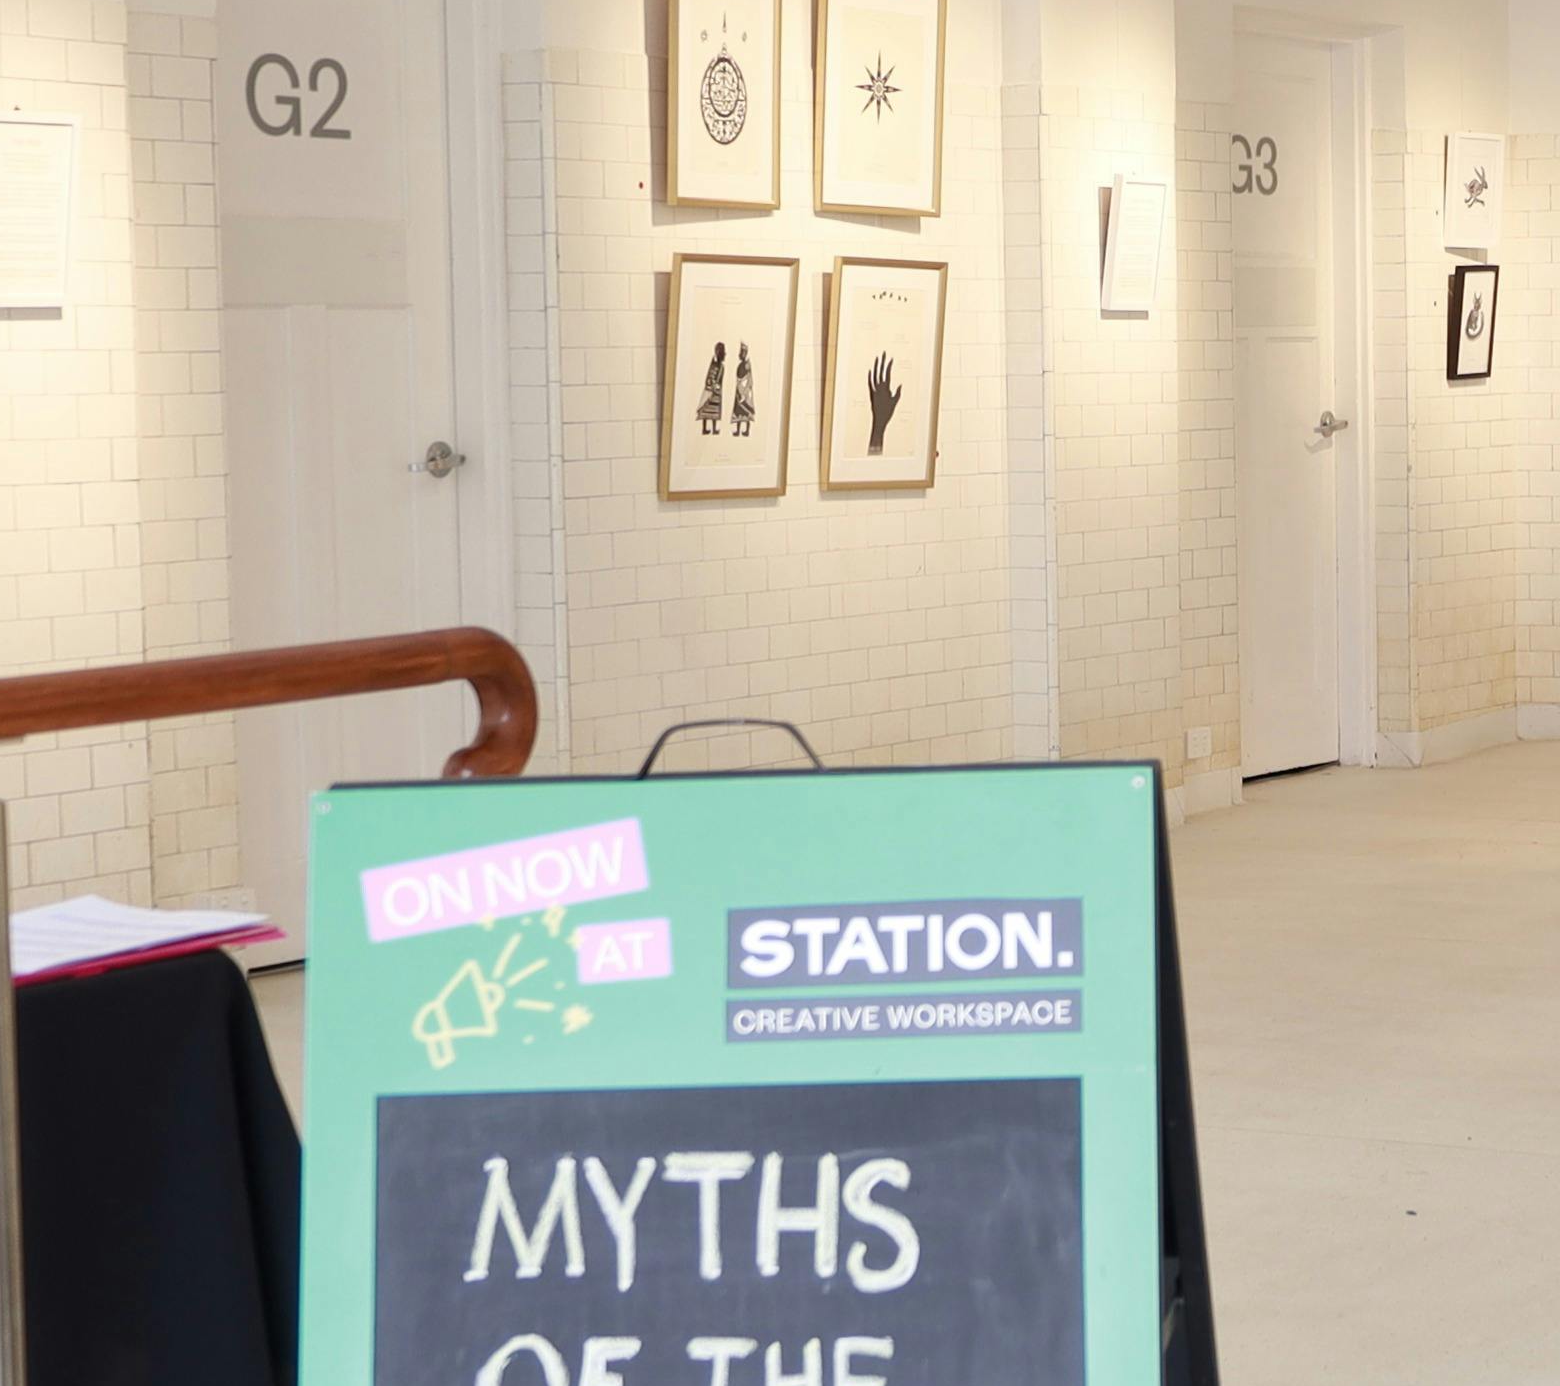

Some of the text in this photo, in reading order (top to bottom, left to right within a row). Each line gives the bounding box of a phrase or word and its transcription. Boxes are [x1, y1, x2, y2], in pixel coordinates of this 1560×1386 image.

[245, 53, 351, 140] G2
[1231, 134, 1278, 195] G3
[381, 835, 625, 927] ON NOW
[592, 930, 655, 975] AT
[739, 911, 1074, 978] STATION.
[732, 998, 1073, 1036] CREATIVE WORKSPACE
[463, 1152, 921, 1292] MYTHS
